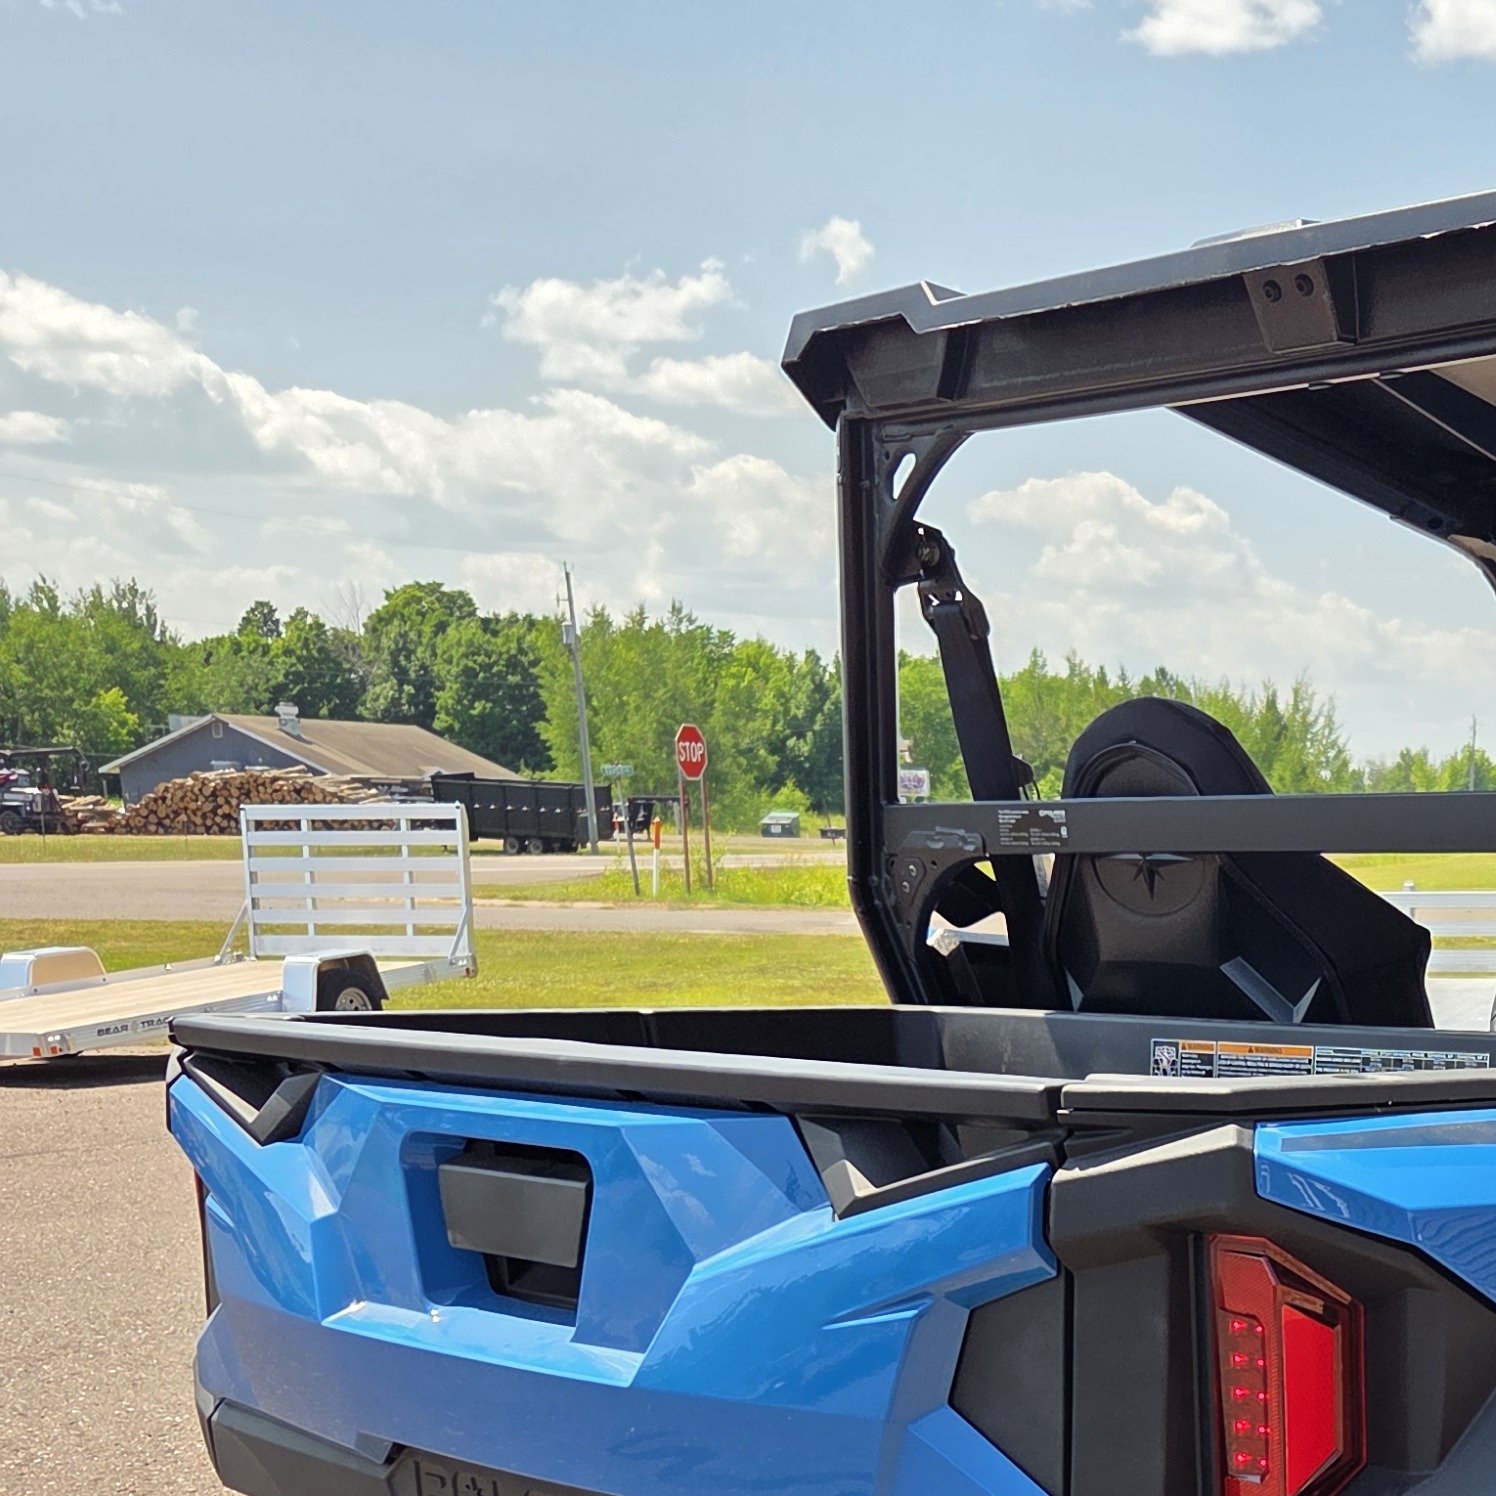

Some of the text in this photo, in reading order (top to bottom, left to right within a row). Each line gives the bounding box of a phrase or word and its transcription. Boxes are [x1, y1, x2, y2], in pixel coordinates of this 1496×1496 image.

[678, 741, 704, 762] STOP
[97, 1024, 129, 1036] BEAR
[140, 1016, 169, 1028] TRAC
